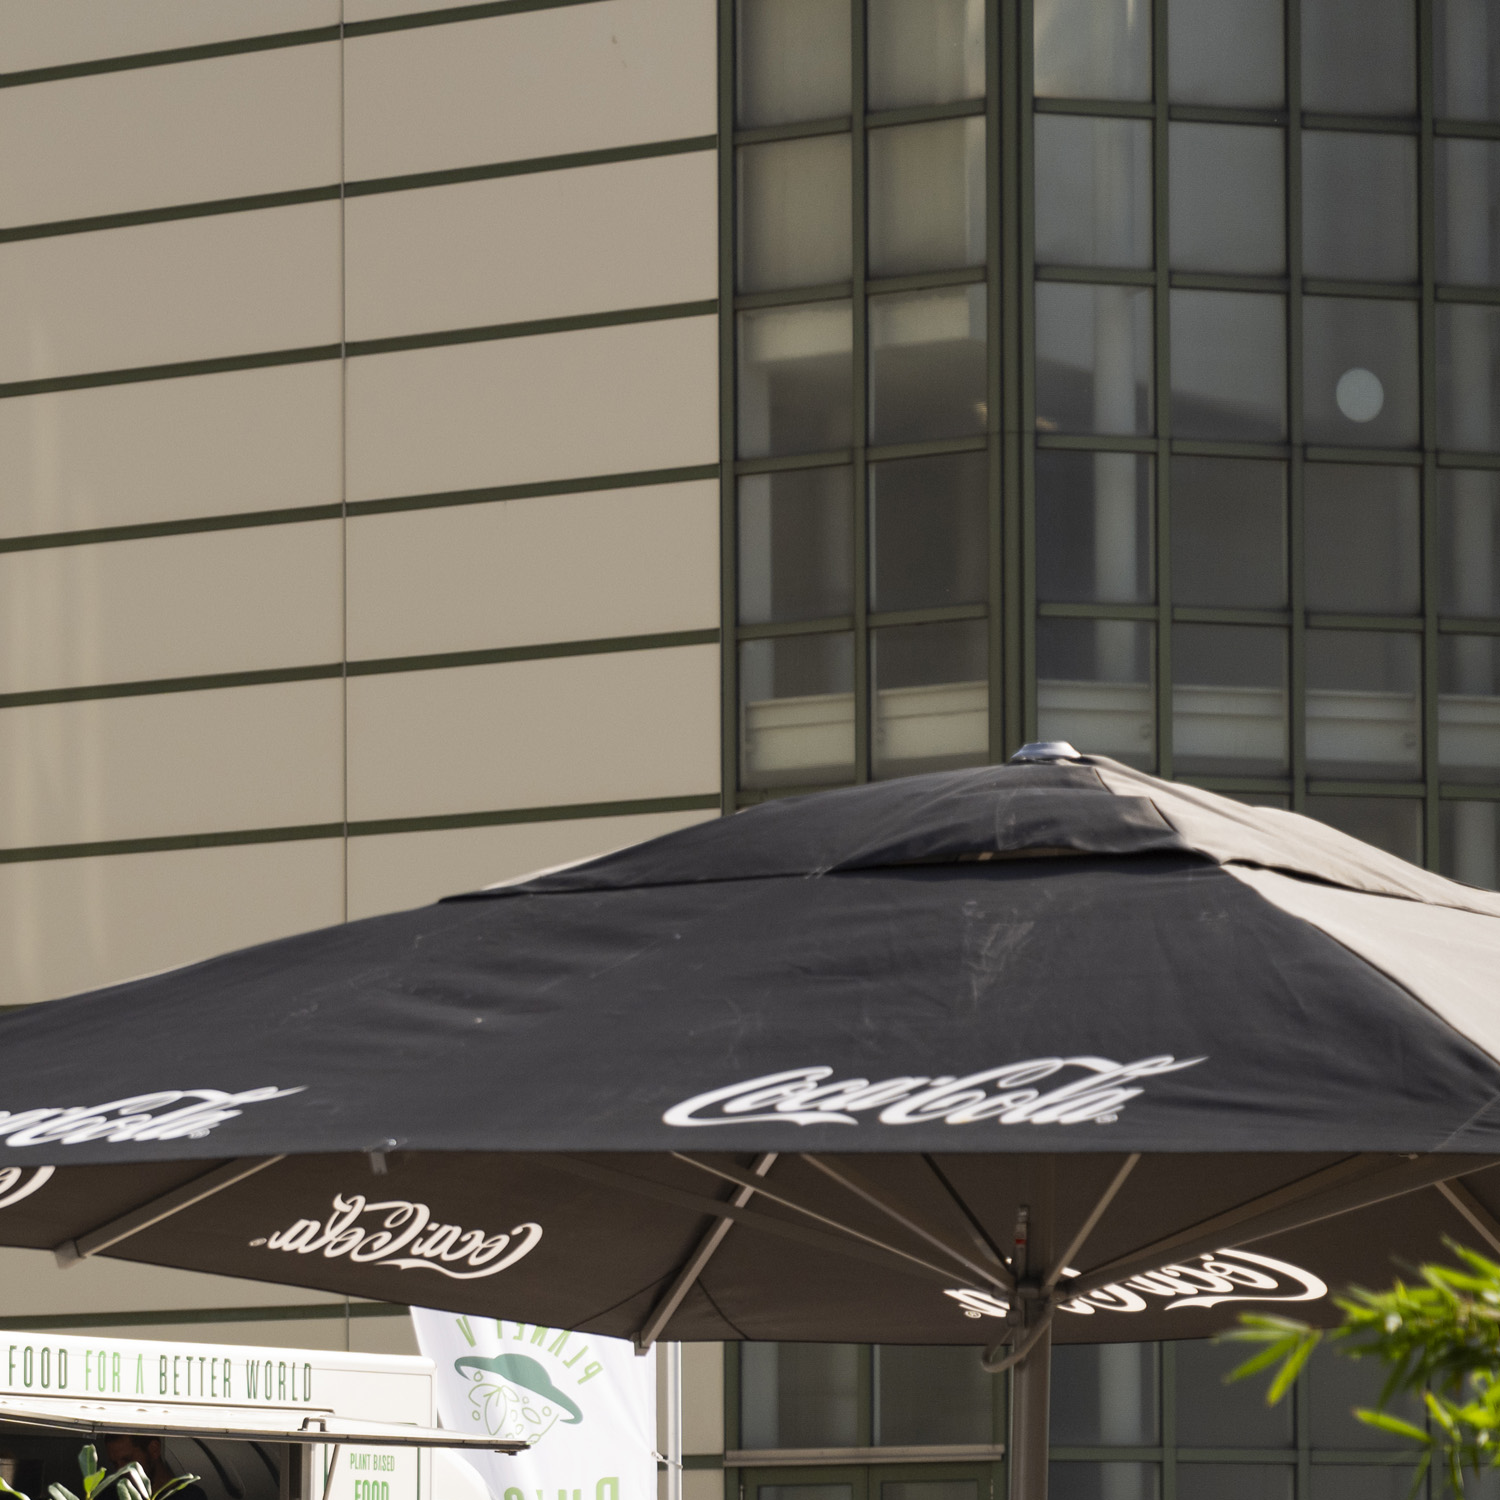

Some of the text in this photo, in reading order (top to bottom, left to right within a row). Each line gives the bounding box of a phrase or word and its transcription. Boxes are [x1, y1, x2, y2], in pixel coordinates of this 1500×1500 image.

[662, 1055, 1210, 1127] Coca-Cola
[9, 1345, 68, 1389] FOOD
[85, 1350, 121, 1393] FOR
[135, 1353, 144, 1394] A
[159, 1354, 232, 1398] BETTER
[246, 1359, 312, 1402] WORLD
[350, 1453, 395, 1472] PLANT BASED
